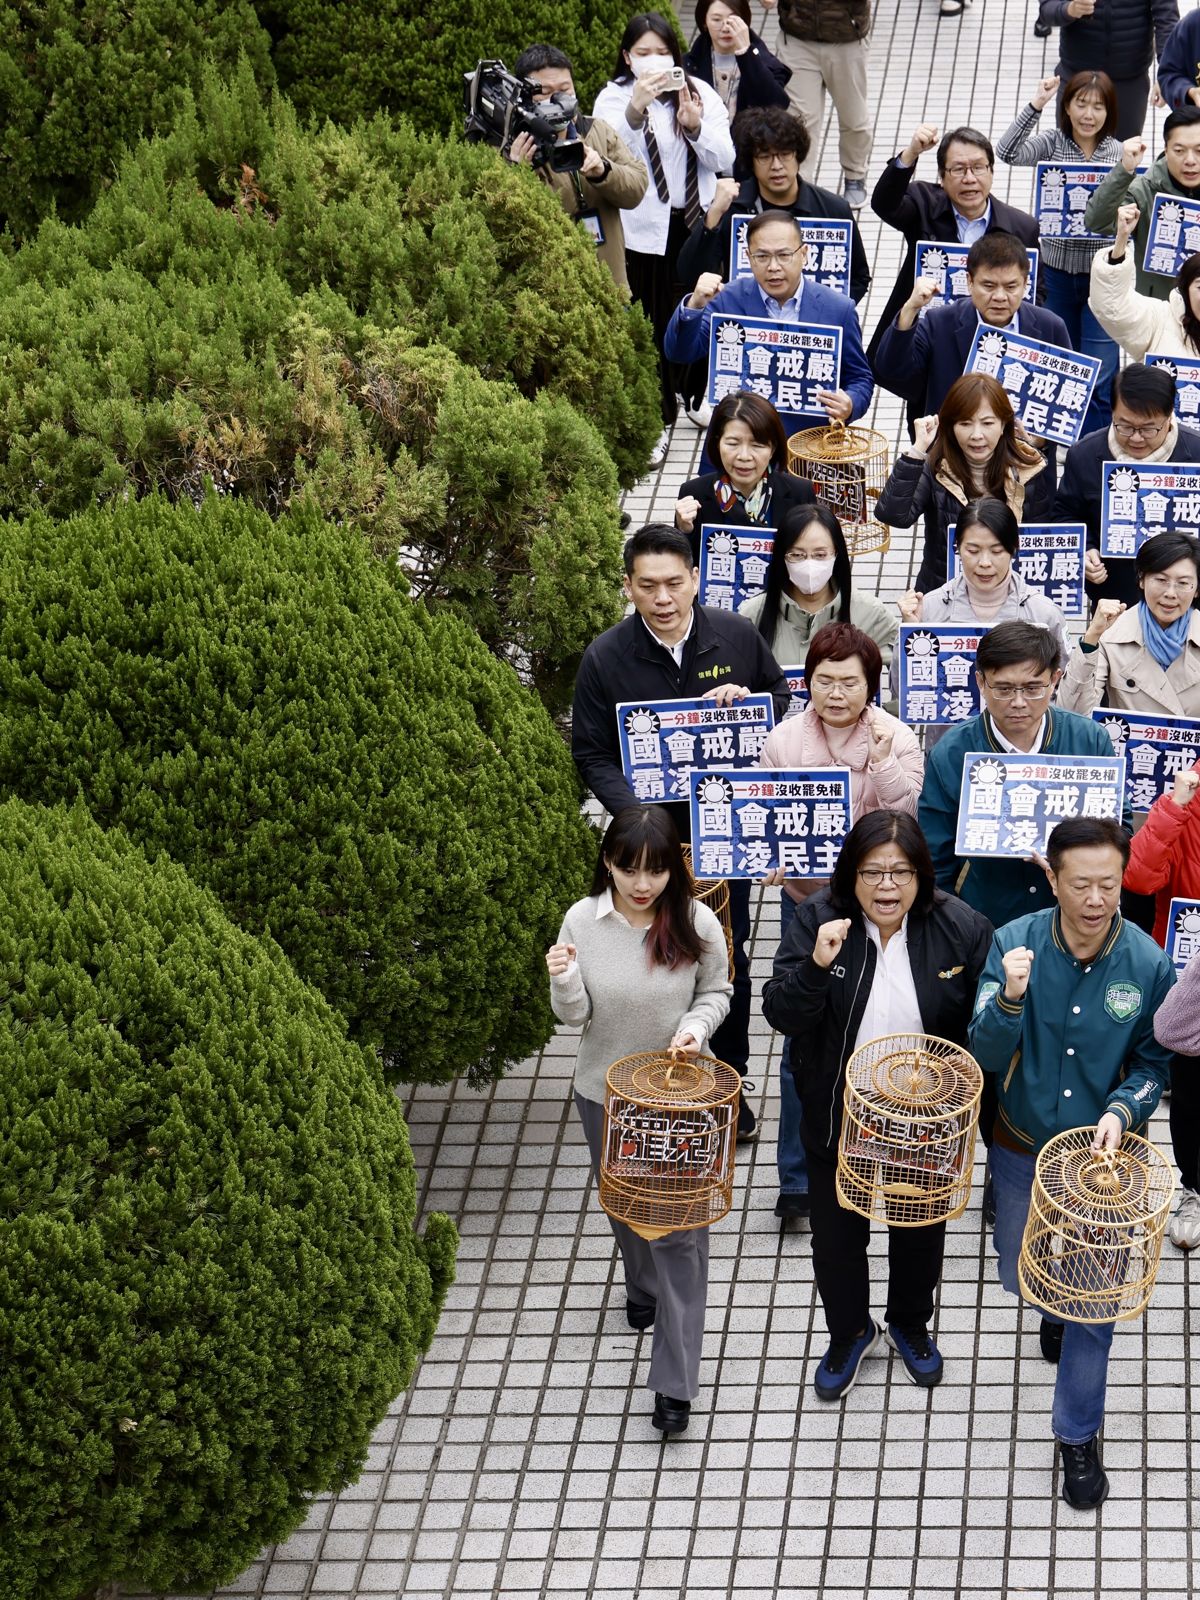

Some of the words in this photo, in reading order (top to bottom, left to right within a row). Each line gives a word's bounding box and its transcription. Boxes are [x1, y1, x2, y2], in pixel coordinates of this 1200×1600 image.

[1008, 767, 1117, 781] 一分鐘沒收罷免權
[734, 784, 843, 797] 一分鐘沒收罷免權
[967, 783, 1118, 819] 國會戒嚴
[699, 802, 847, 837] 國會戒嚴
